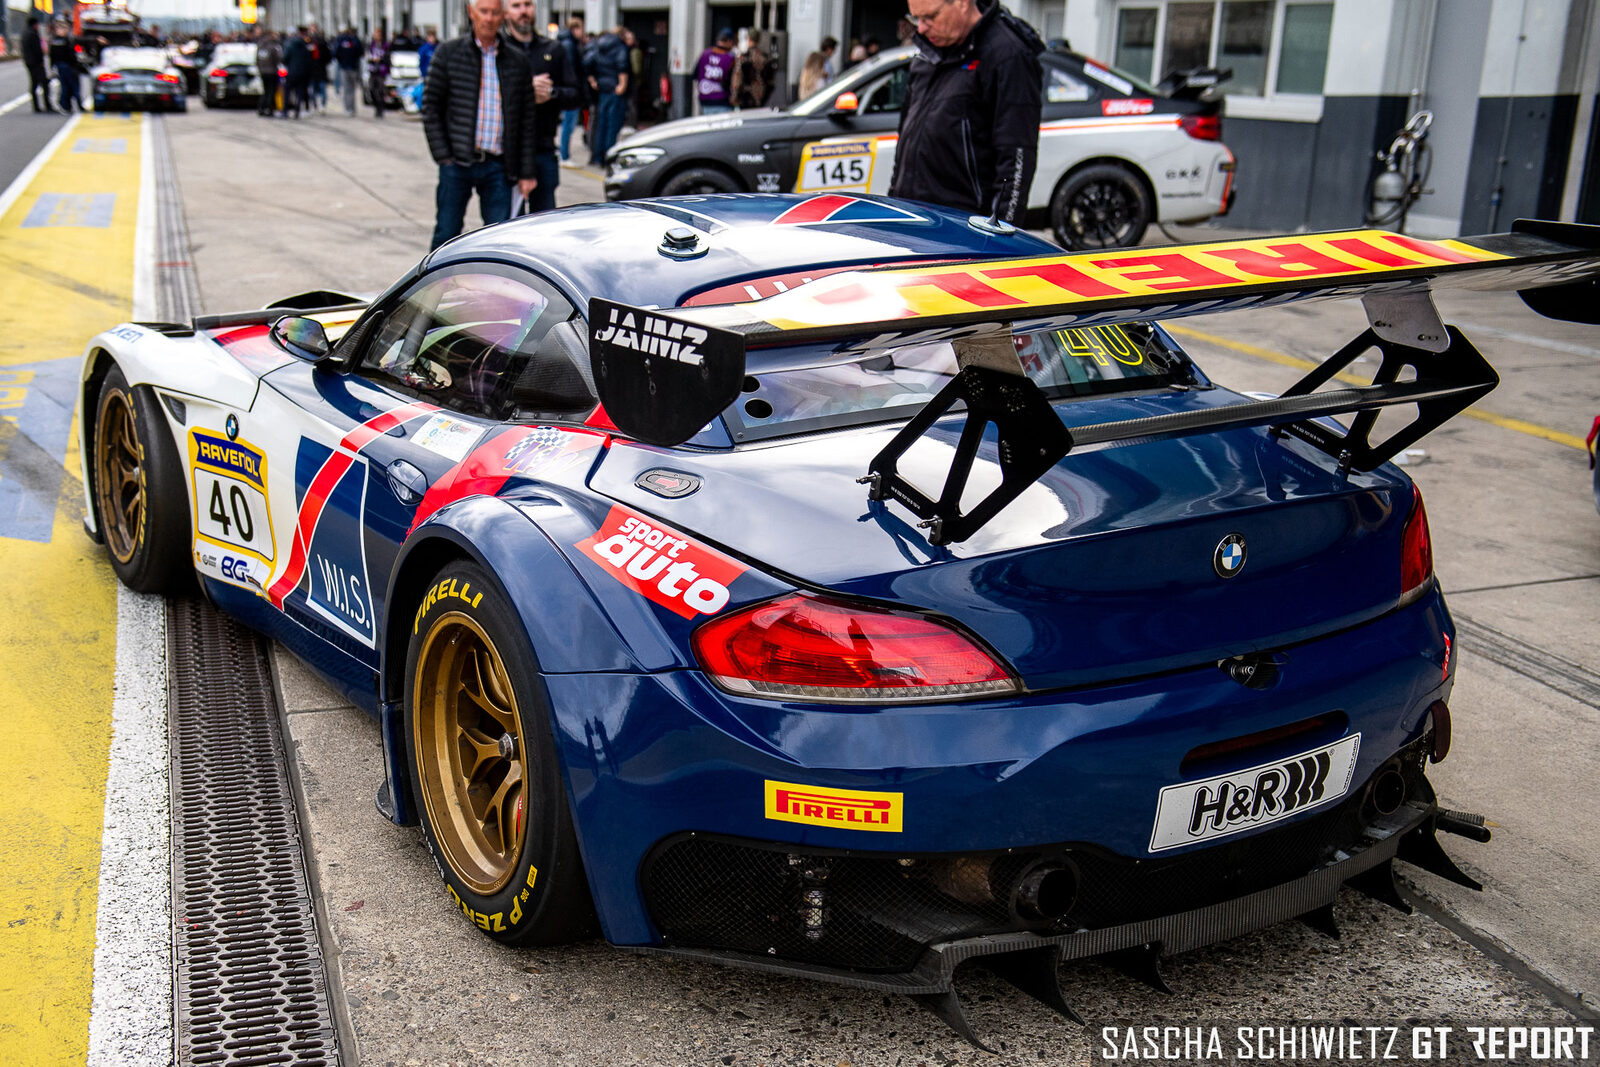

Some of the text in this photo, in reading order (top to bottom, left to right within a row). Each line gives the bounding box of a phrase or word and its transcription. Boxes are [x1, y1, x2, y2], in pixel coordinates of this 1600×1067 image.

[816, 159, 864, 184] 145
[200, 441, 259, 477] RAVENOL
[209, 479, 254, 542] 40
[618, 517, 689, 558] sport
[316, 553, 370, 629] W.I.S.
[593, 533, 731, 616] auto
[414, 578, 484, 635] PIRELLI
[776, 789, 891, 825] PIRELLI
[1188, 767, 1286, 836] H&R
[509, 895, 523, 925] P
